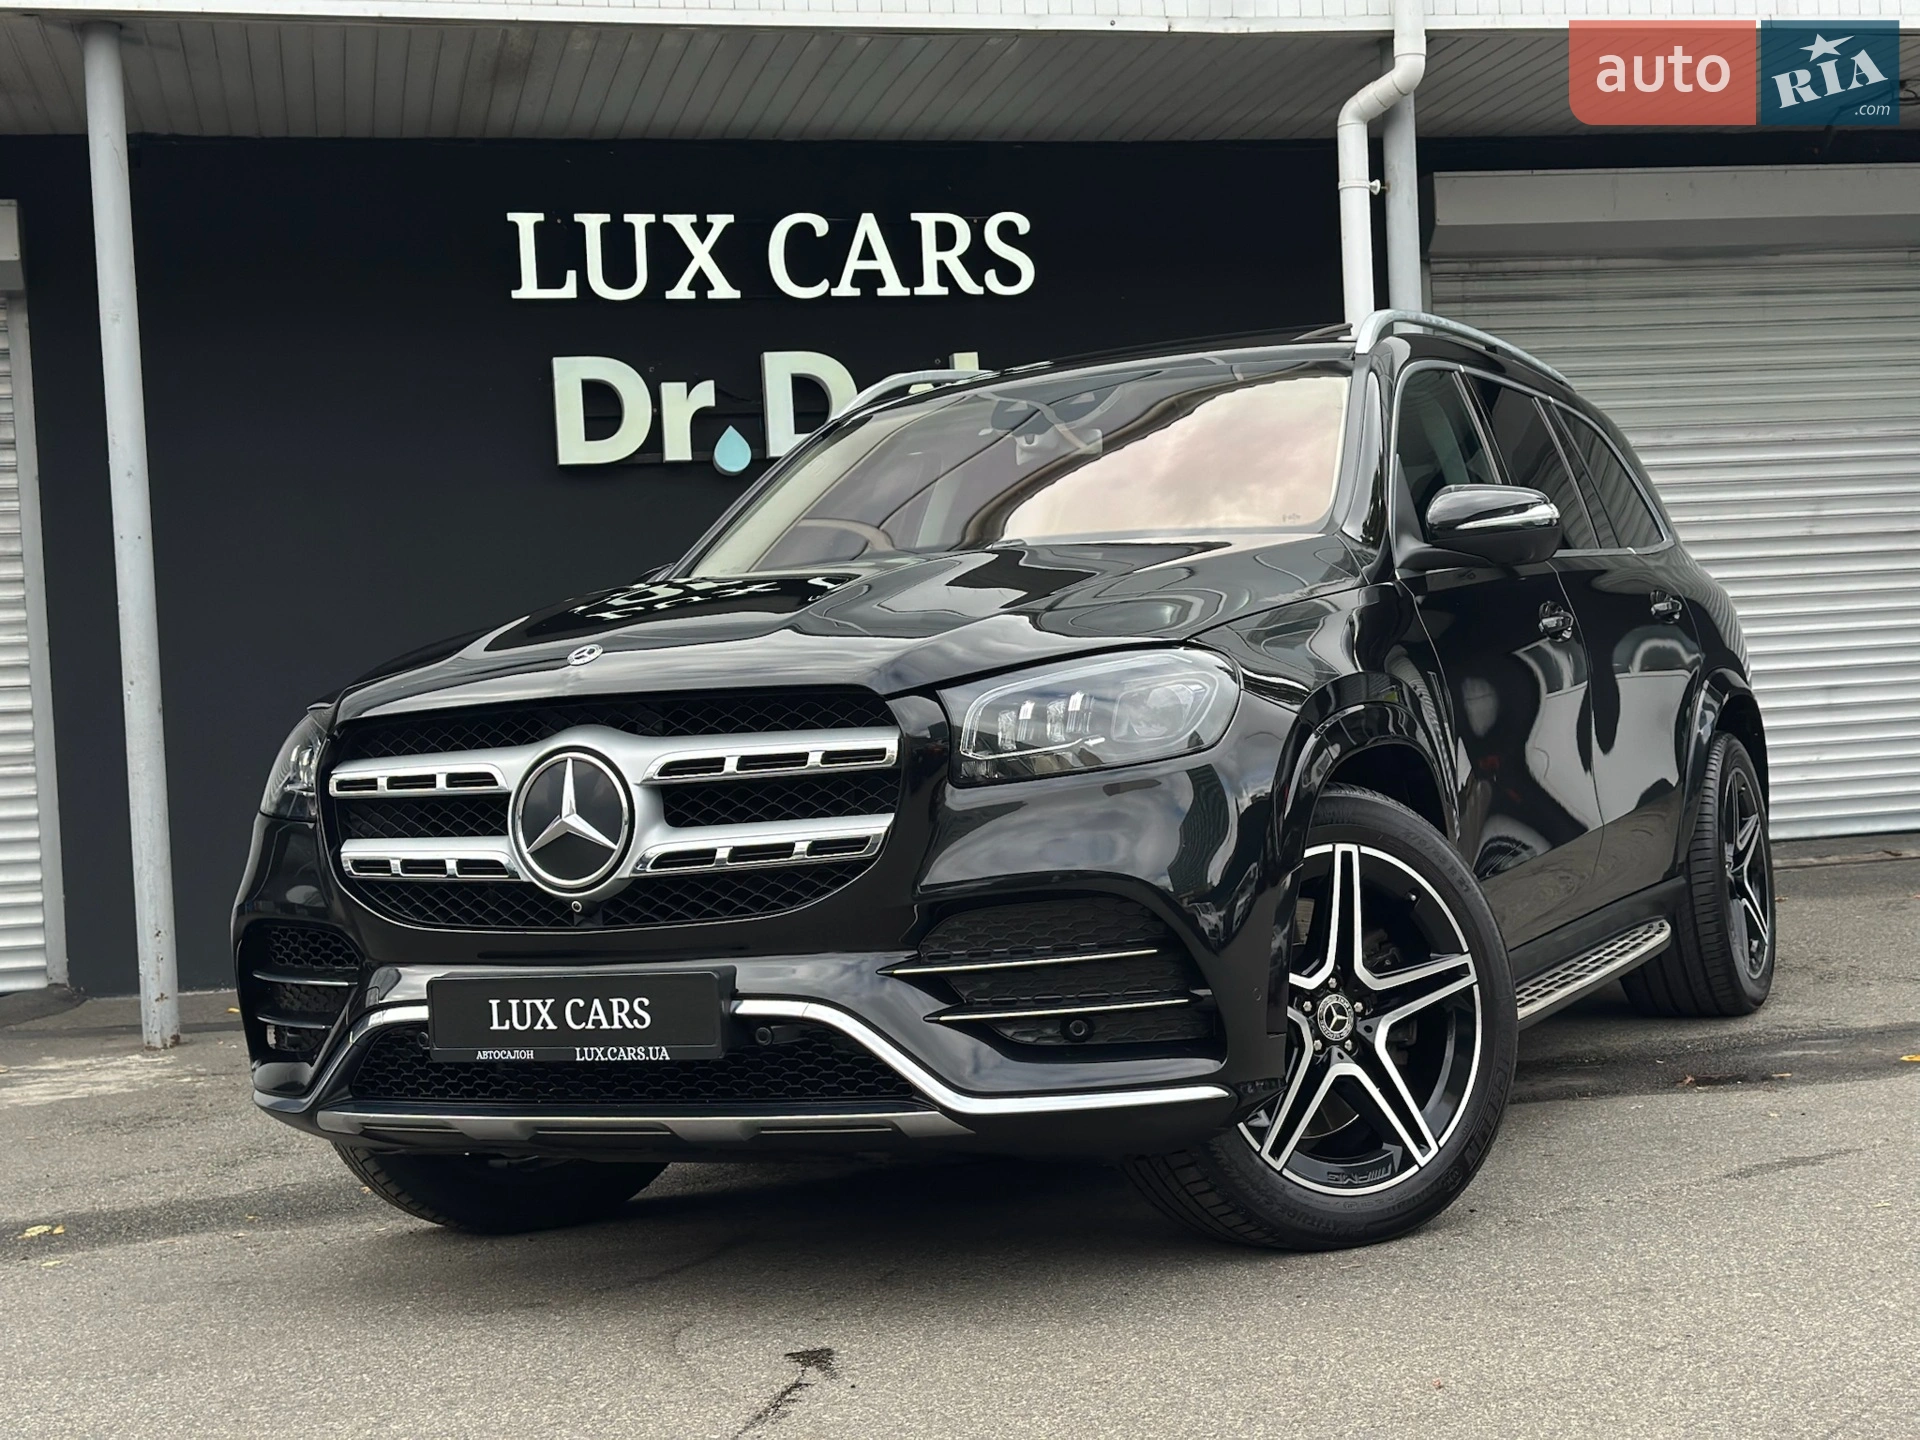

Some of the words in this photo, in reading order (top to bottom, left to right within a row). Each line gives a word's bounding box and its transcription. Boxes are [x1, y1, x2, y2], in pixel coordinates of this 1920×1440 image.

[506, 212, 741, 301] LUX
[768, 211, 1036, 299] CARS
[489, 998, 558, 1031] LUX
[564, 997, 652, 1030] CARS
[476, 1050, 534, 1060] АВТОСАЛОН
[575, 1046, 671, 1061] LUX.CARS.UA
